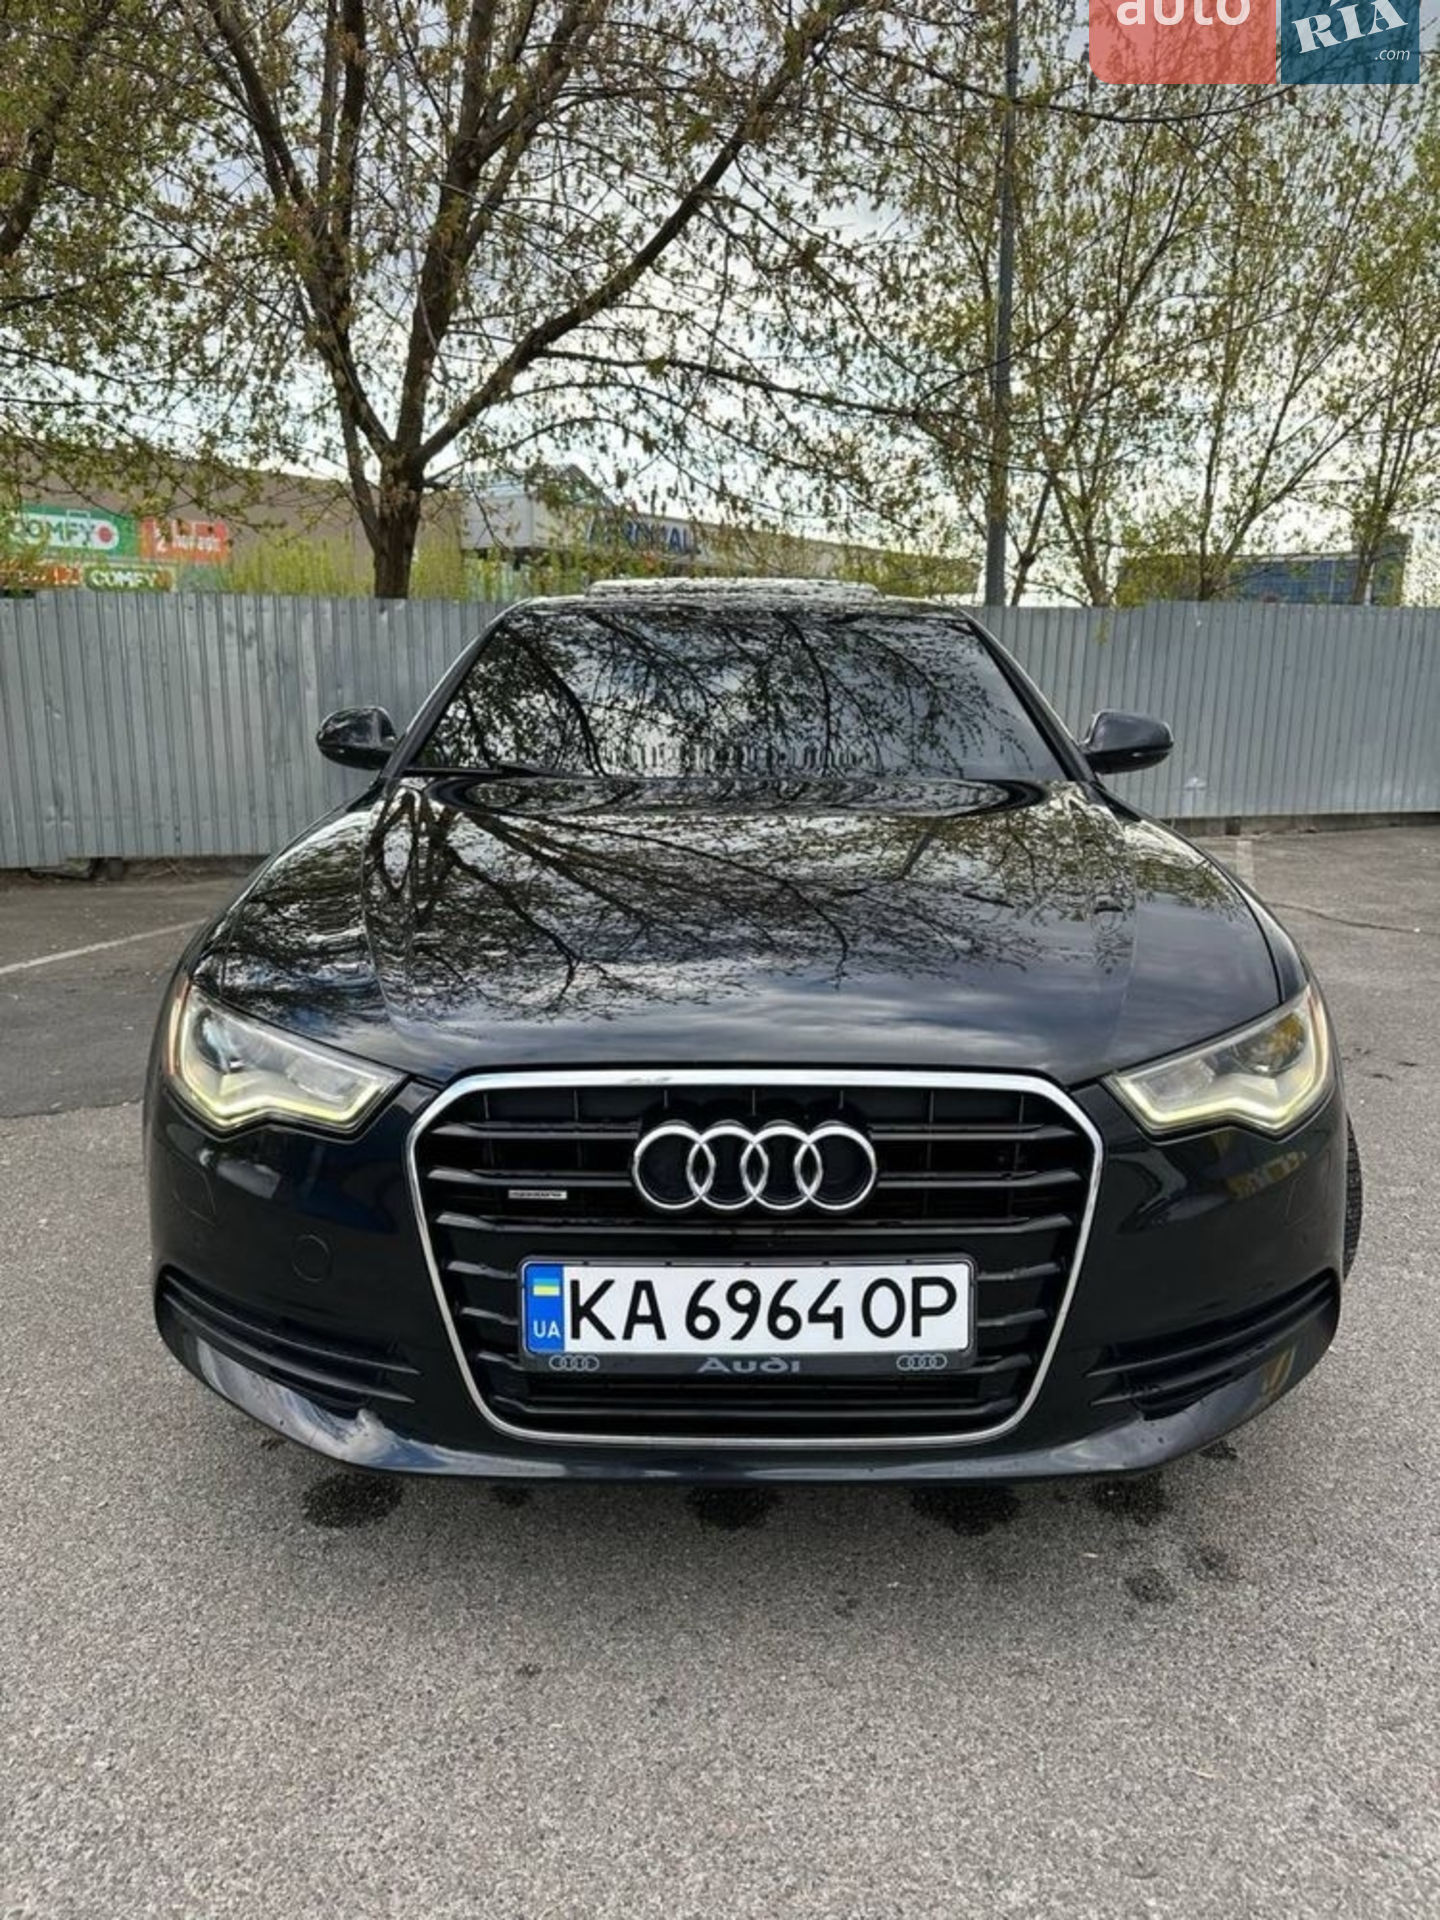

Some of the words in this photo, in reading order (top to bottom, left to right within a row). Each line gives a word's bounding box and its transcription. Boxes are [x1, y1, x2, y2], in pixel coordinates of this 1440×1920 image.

[89, 569, 157, 588] COMFY
[569, 1279, 667, 1341] KA
[685, 1279, 844, 1341] 6964
[861, 1276, 957, 1339] OP
[533, 1320, 562, 1339] UA
